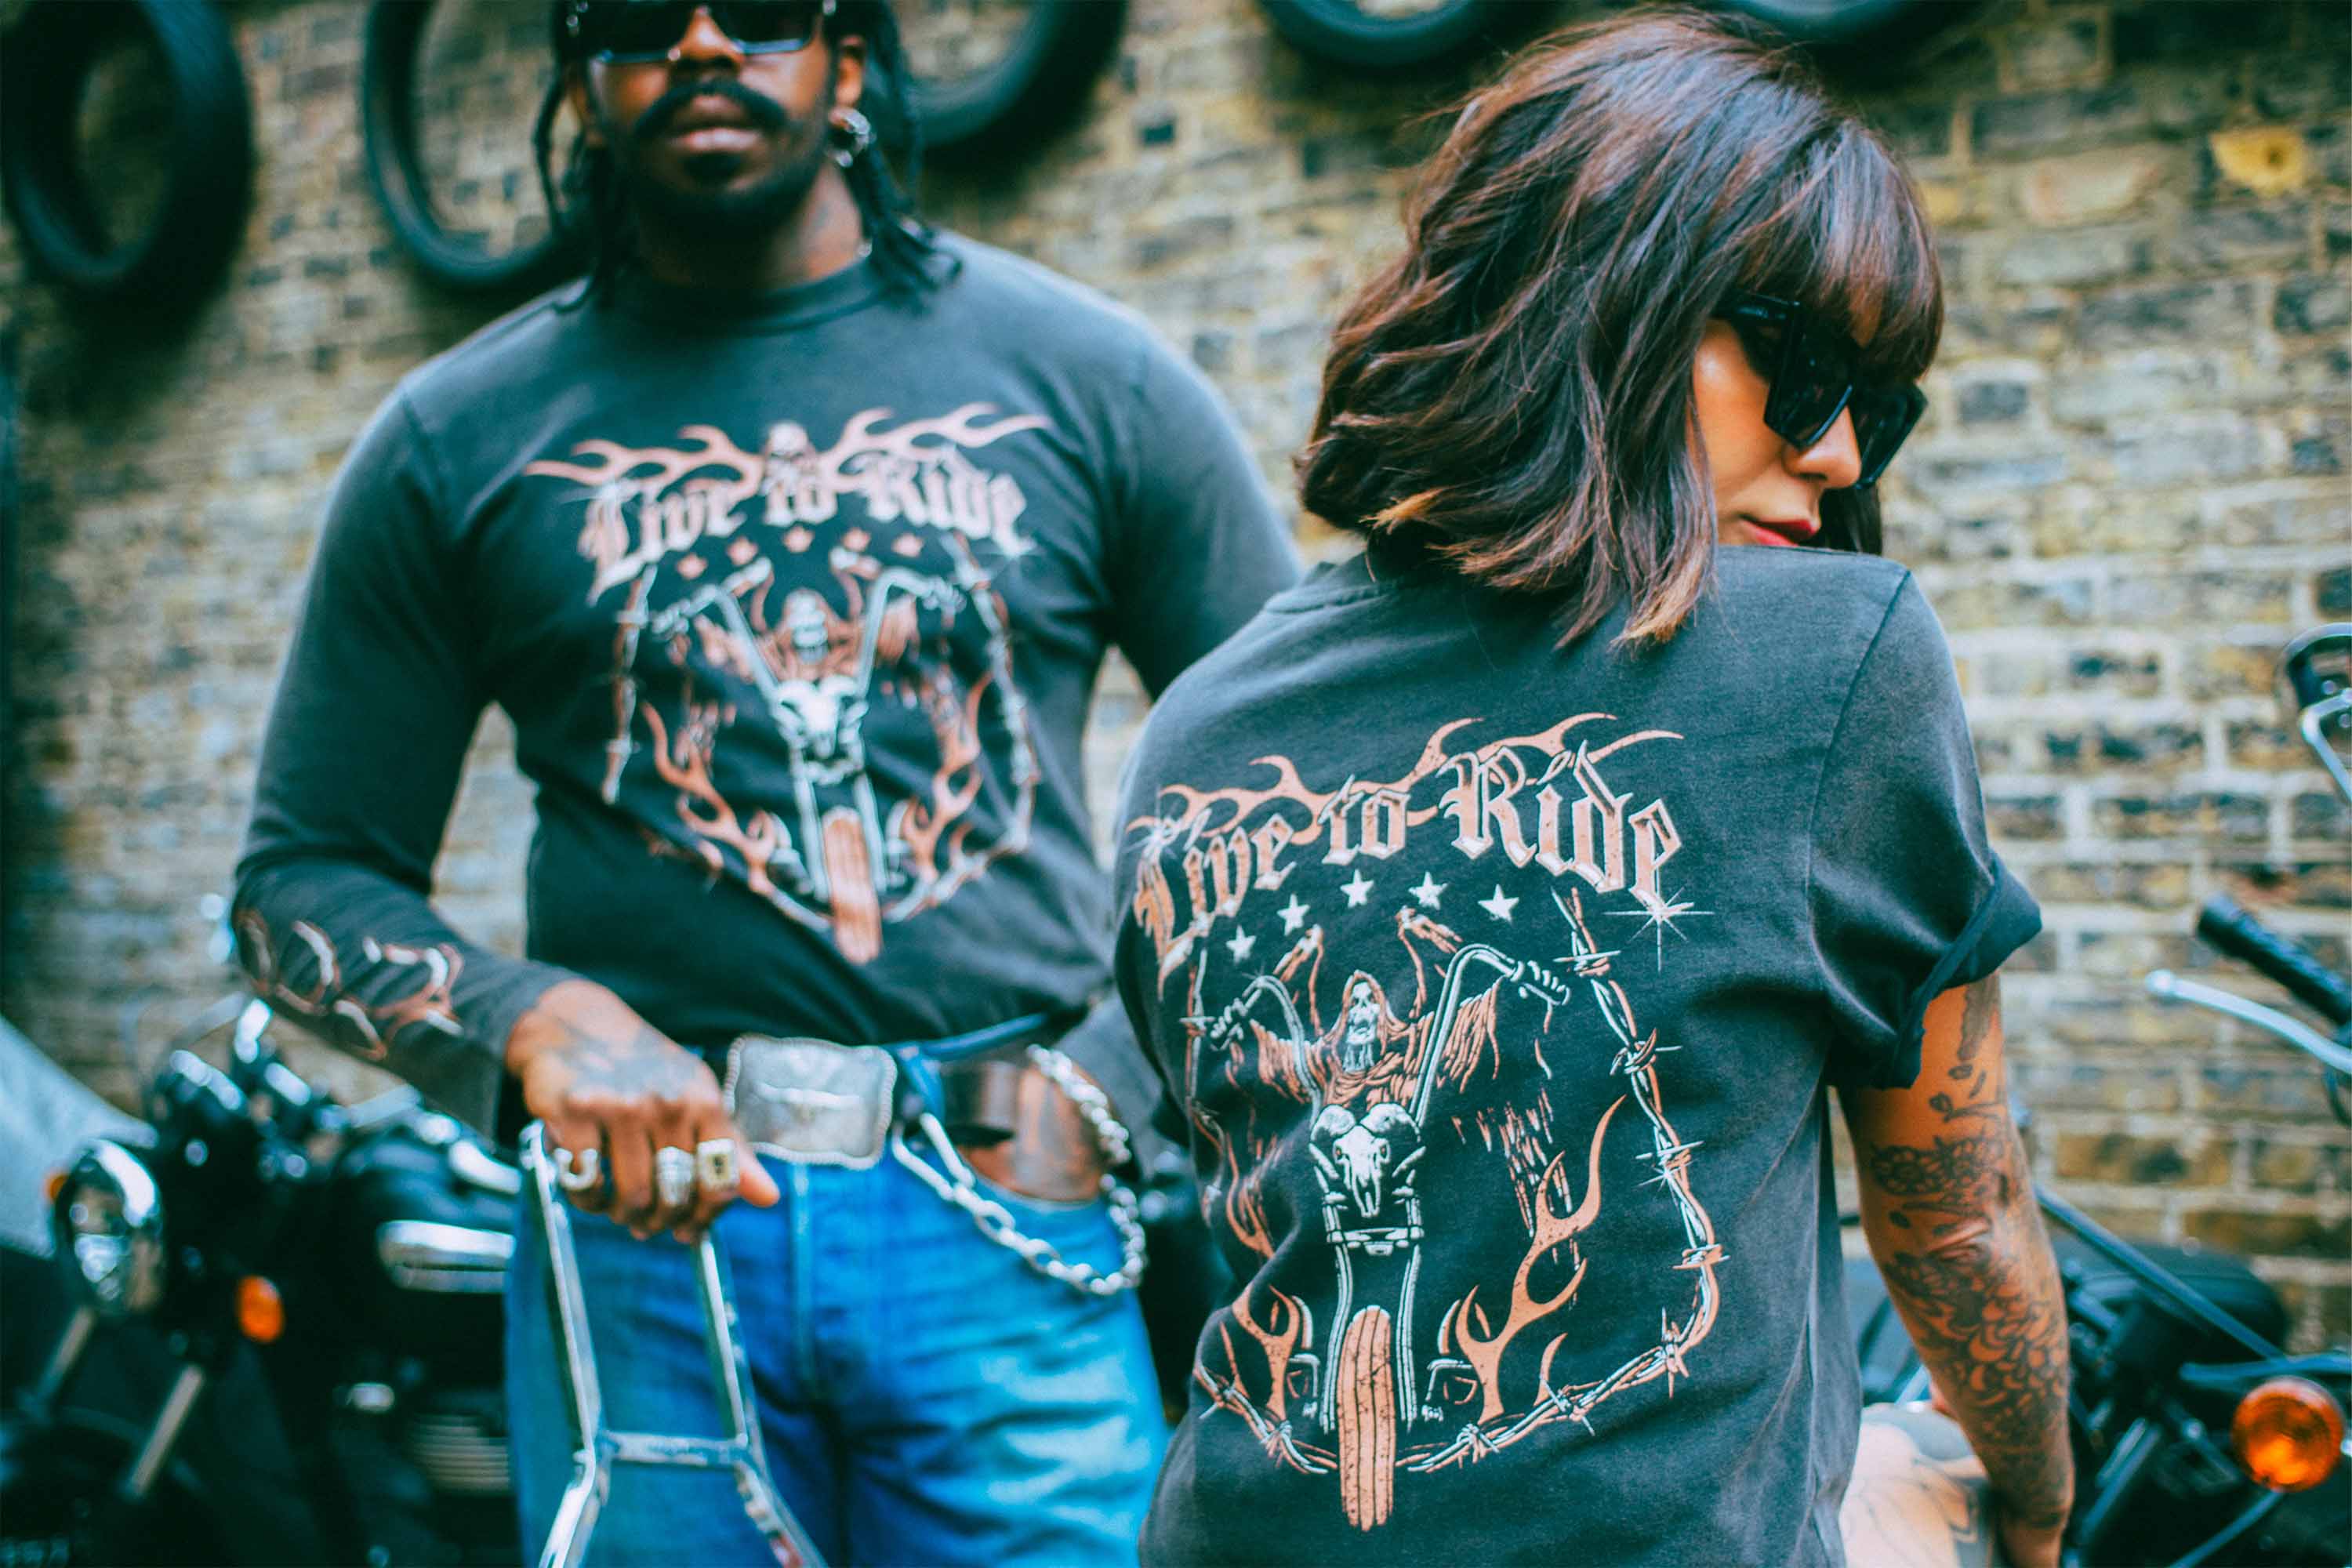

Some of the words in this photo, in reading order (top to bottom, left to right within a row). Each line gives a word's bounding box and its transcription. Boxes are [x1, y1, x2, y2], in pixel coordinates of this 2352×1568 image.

[578, 480, 744, 606] Live
[762, 457, 837, 526] to
[855, 445, 1037, 558] Ride
[1134, 805, 1296, 1002] Live
[1319, 775, 1411, 864] to
[1438, 740, 1693, 919] Ride
